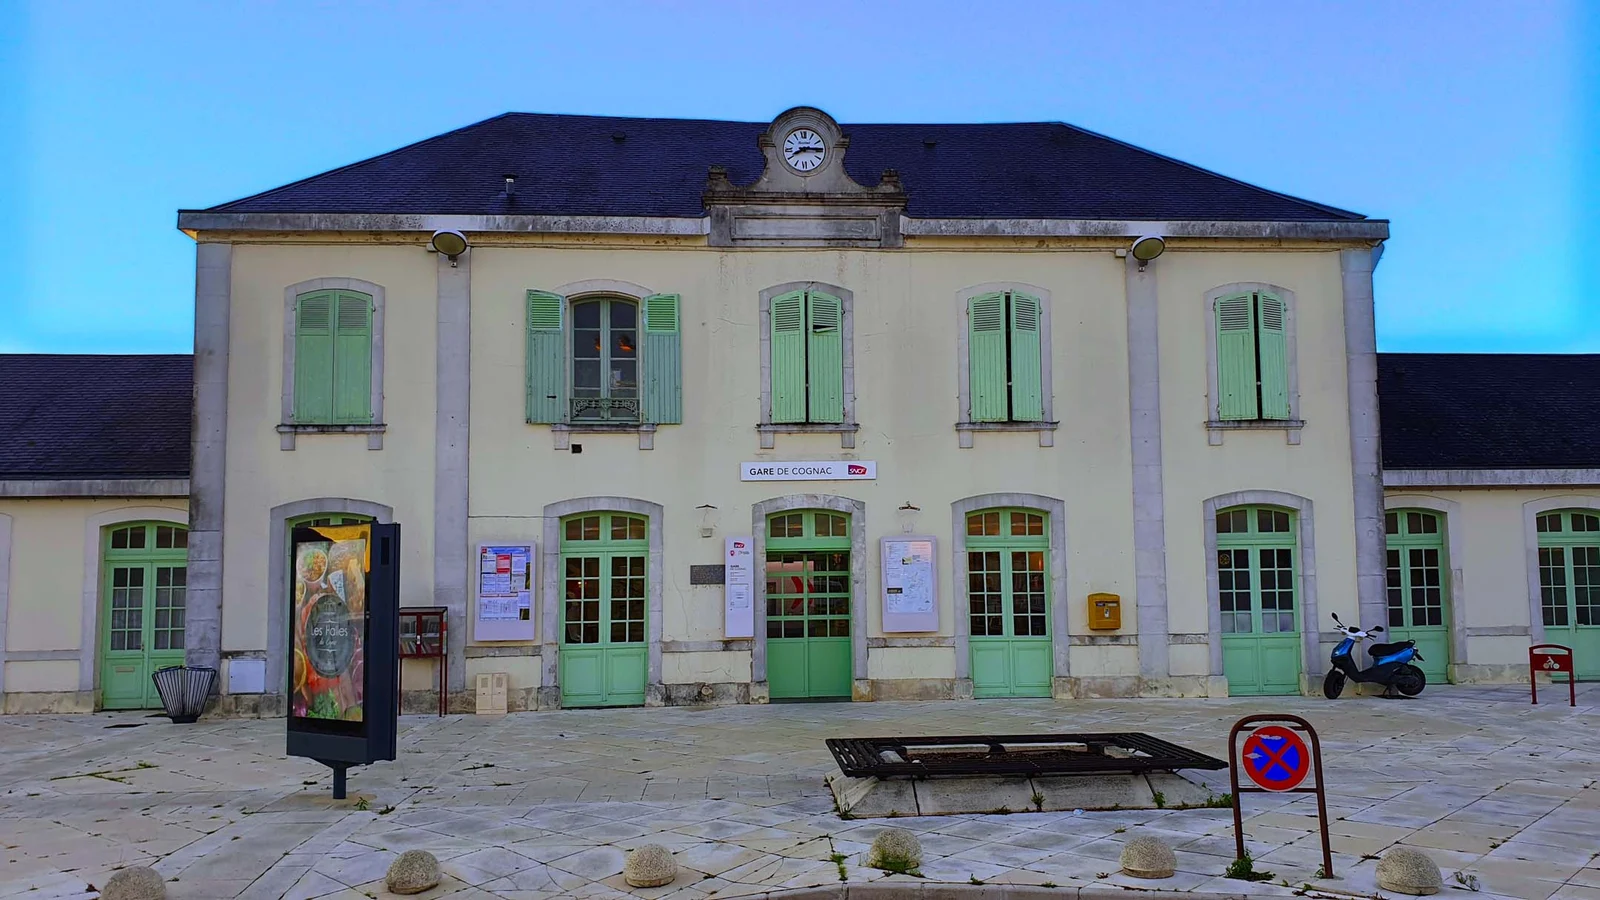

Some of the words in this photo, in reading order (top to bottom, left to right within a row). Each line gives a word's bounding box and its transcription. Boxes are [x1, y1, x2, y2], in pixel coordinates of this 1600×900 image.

[749, 467, 775, 476] GARE
[776, 467, 789, 476] DE
[791, 466, 832, 475] COGNAC
[848, 467, 866, 476] SNCF
